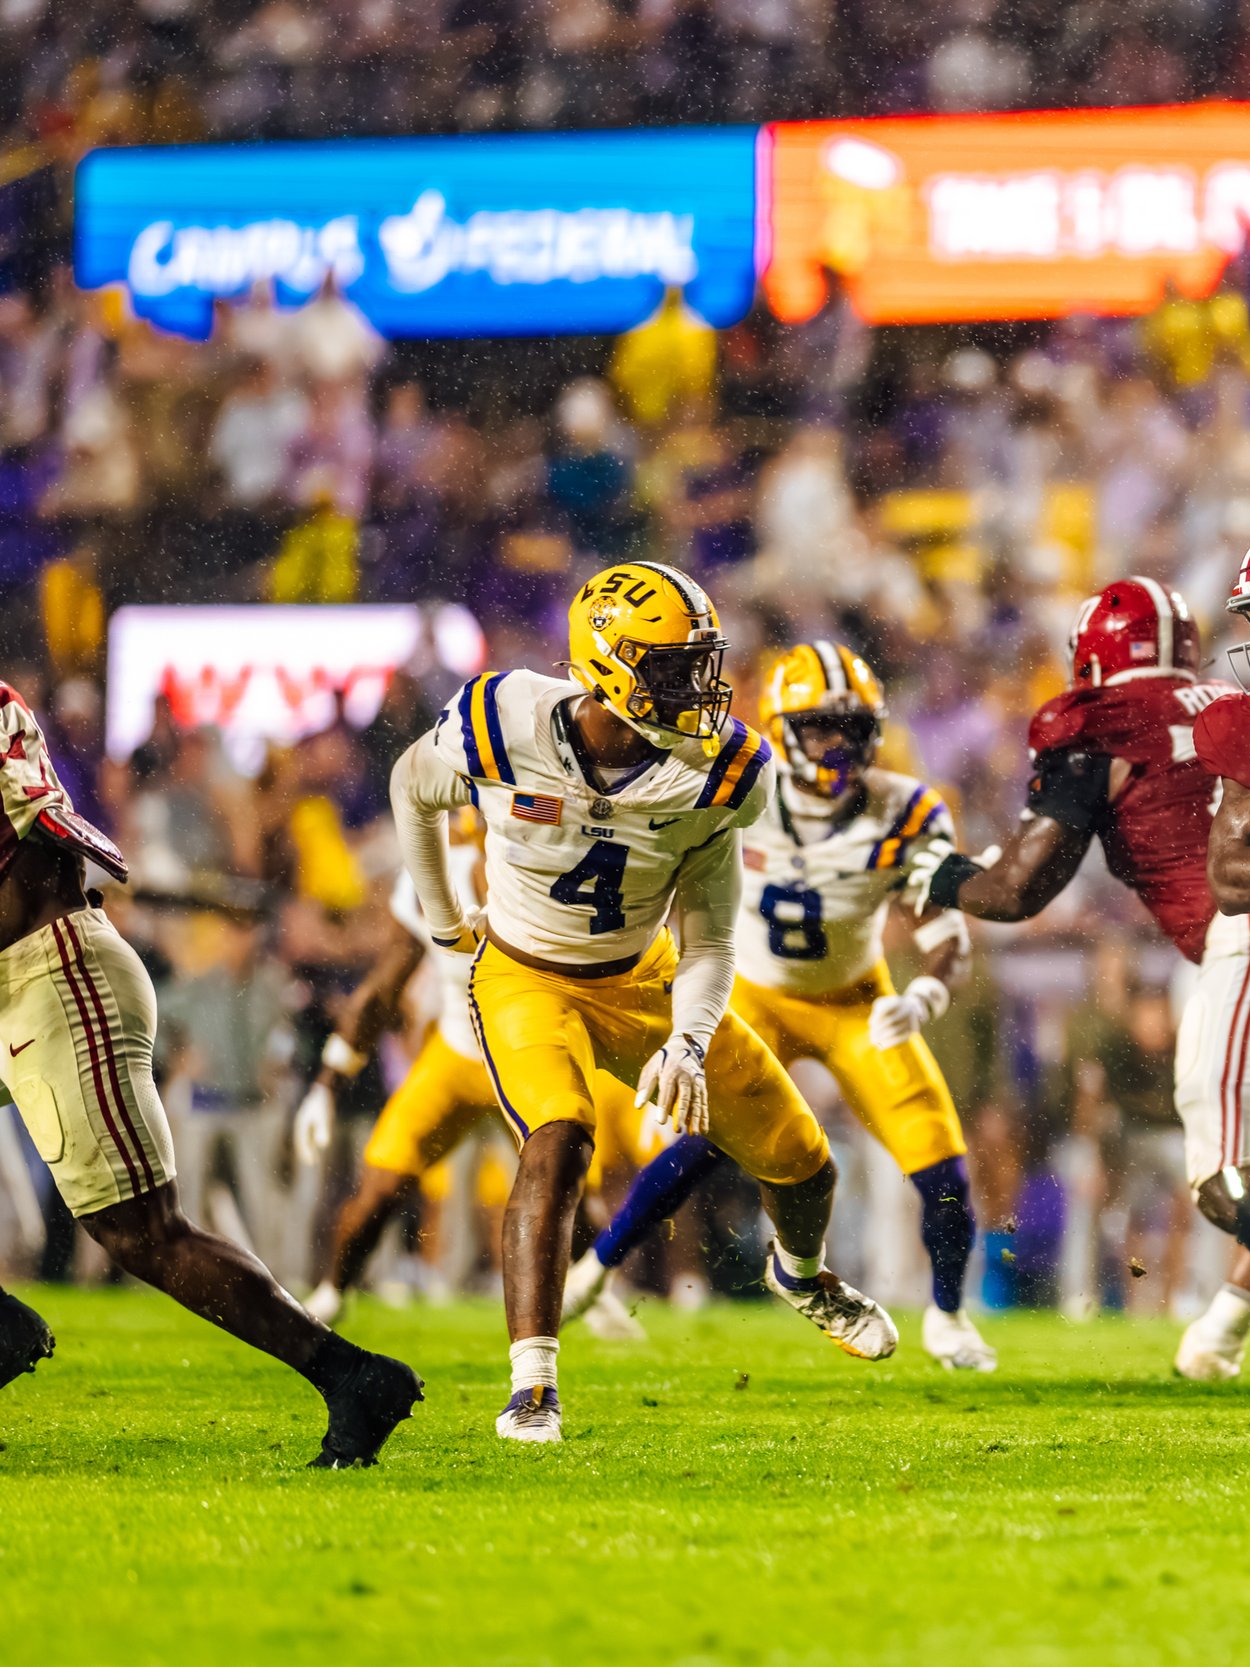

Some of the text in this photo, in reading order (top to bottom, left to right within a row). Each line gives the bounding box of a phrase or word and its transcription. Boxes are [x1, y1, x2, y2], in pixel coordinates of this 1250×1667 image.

[581, 825, 614, 839] LSU
[549, 839, 631, 935] 4
[759, 881, 829, 960] 8
